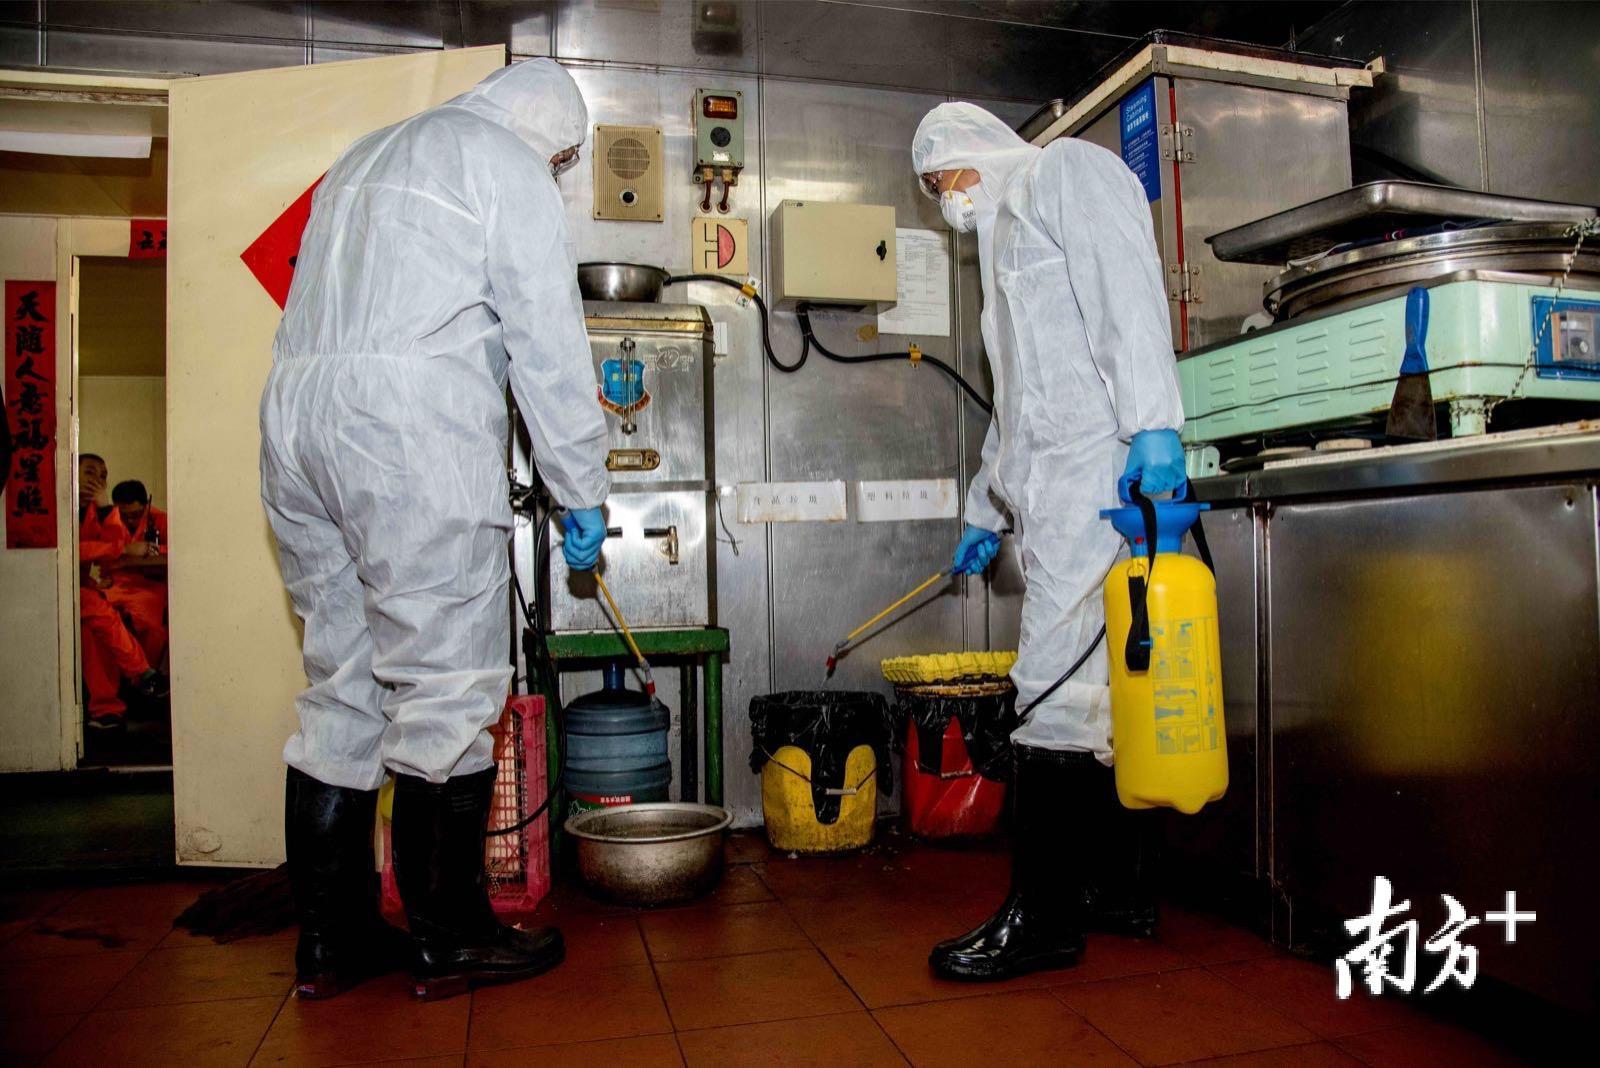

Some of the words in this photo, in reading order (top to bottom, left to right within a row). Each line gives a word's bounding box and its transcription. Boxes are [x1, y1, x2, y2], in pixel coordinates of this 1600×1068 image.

[753, 494, 818, 506] 食品垃圾
[867, 489, 928, 502] 塑料垃圾
